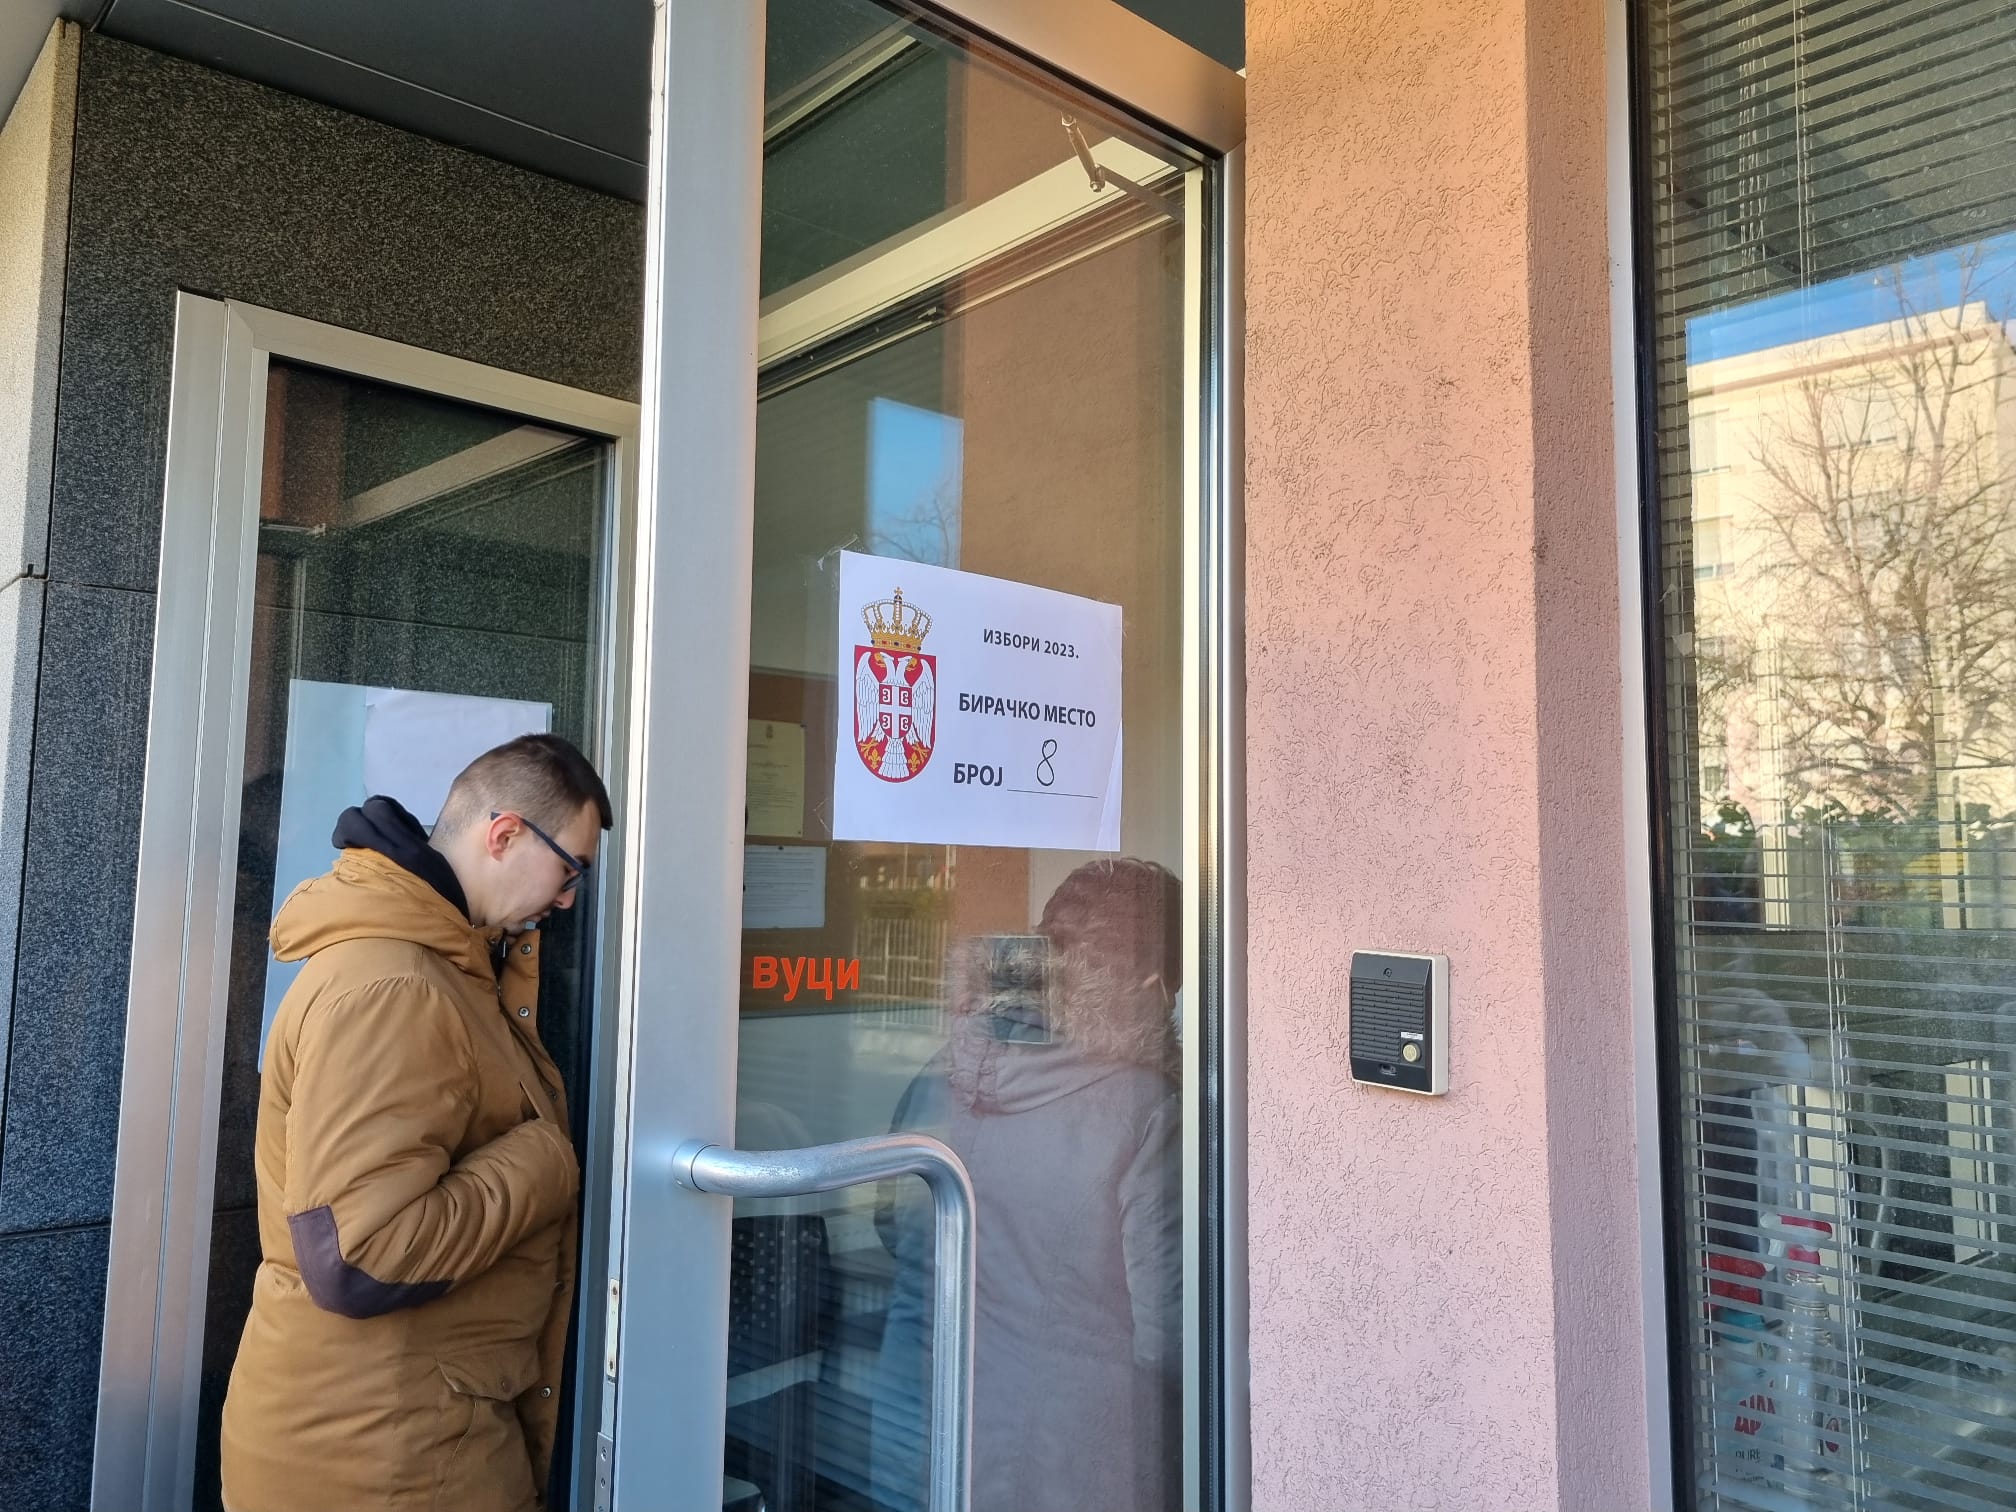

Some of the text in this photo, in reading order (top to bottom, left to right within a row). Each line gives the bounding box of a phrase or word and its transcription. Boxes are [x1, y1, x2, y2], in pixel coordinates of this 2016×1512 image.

[983, 628, 1079, 659] ИЗБОРИ 2023.
[959, 692, 1096, 727] БИРАЧКО МЕСТО
[953, 739, 1058, 787] БРОЈ 8
